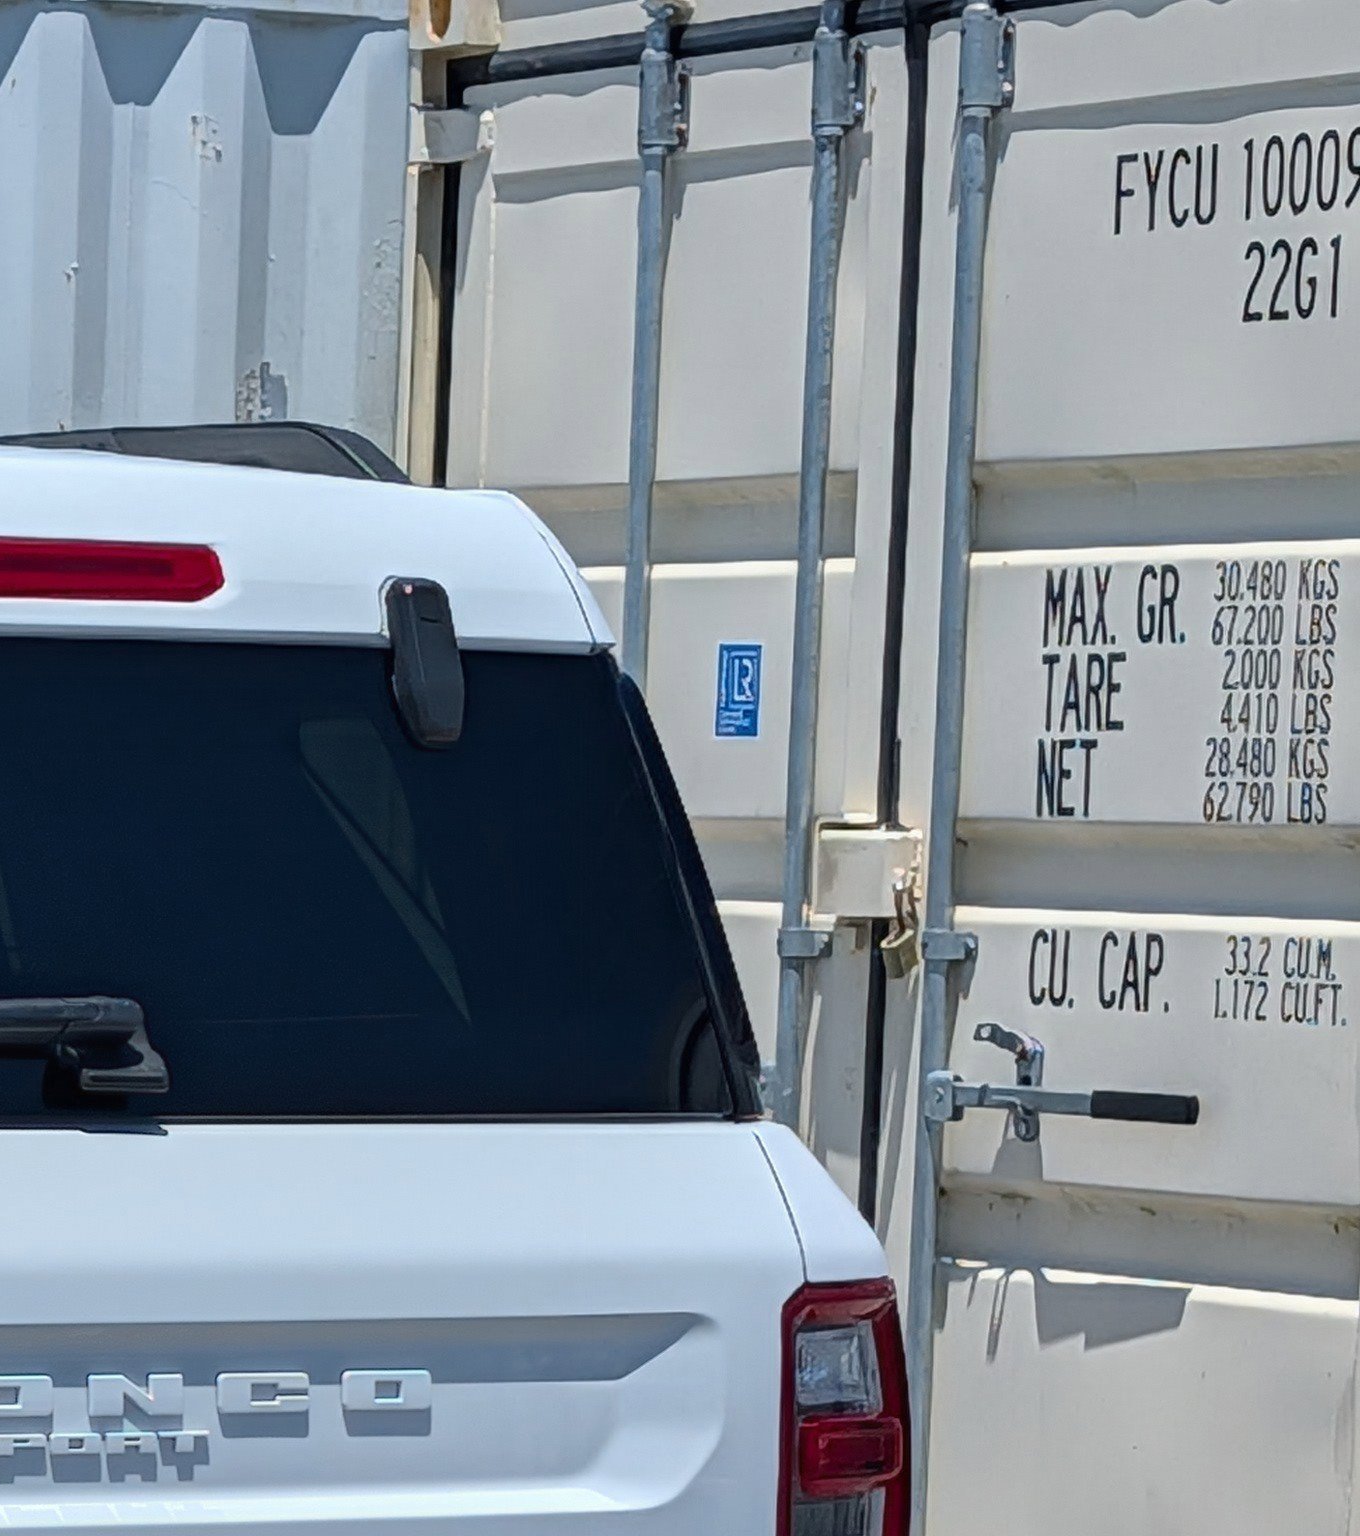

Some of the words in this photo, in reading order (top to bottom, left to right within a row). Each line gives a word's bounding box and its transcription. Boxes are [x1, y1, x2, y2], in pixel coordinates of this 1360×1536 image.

[1114, 143, 1218, 235] FYCU
[1242, 234, 1342, 323] 22G1
[1214, 560, 1287, 601] 30.480
[1298, 558, 1341, 600] KGS
[1043, 564, 1117, 648] MAX.
[1137, 564, 1186, 644] GR.
[1211, 604, 1285, 645] 67.200
[1295, 603, 1337, 645] LBS
[1293, 648, 1335, 690] KGS
[1042, 651, 1127, 732] TARE
[1290, 693, 1332, 735] LBS
[1036, 737, 1098, 818] NET
[1205, 737, 1276, 778] 28.480
[1288, 738, 1329, 779] KGS
[1287, 782, 1328, 825] LBS
[1029, 928, 1074, 1009] CU.
[1098, 930, 1169, 1013] CAP.
[1224, 934, 1272, 977] 33.2
